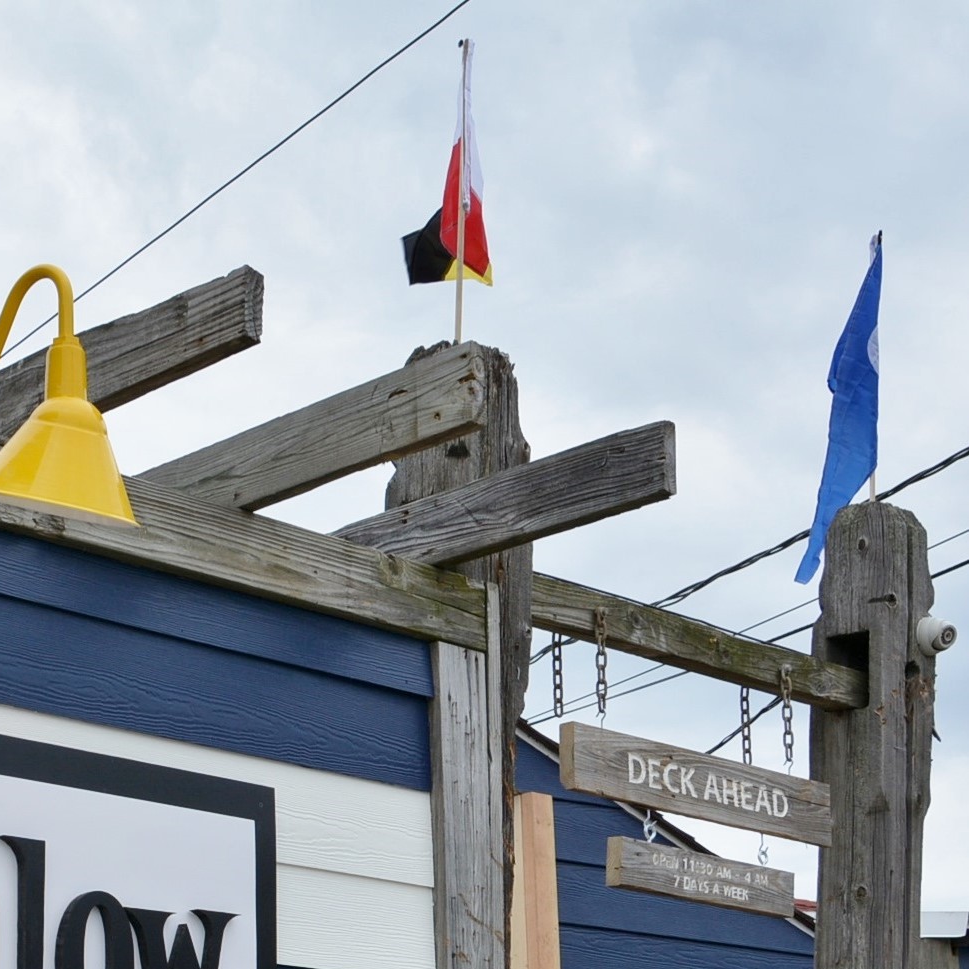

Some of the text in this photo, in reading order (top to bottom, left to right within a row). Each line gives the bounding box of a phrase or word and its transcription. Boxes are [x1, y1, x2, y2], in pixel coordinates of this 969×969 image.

[628, 752, 789, 818] DECK AHEAD
[652, 852, 679, 870] OPEN
[716, 865, 732, 880] AM
[744, 871, 752, 884] 4
[673, 875, 750, 901] 7 DAYS A WEEK
